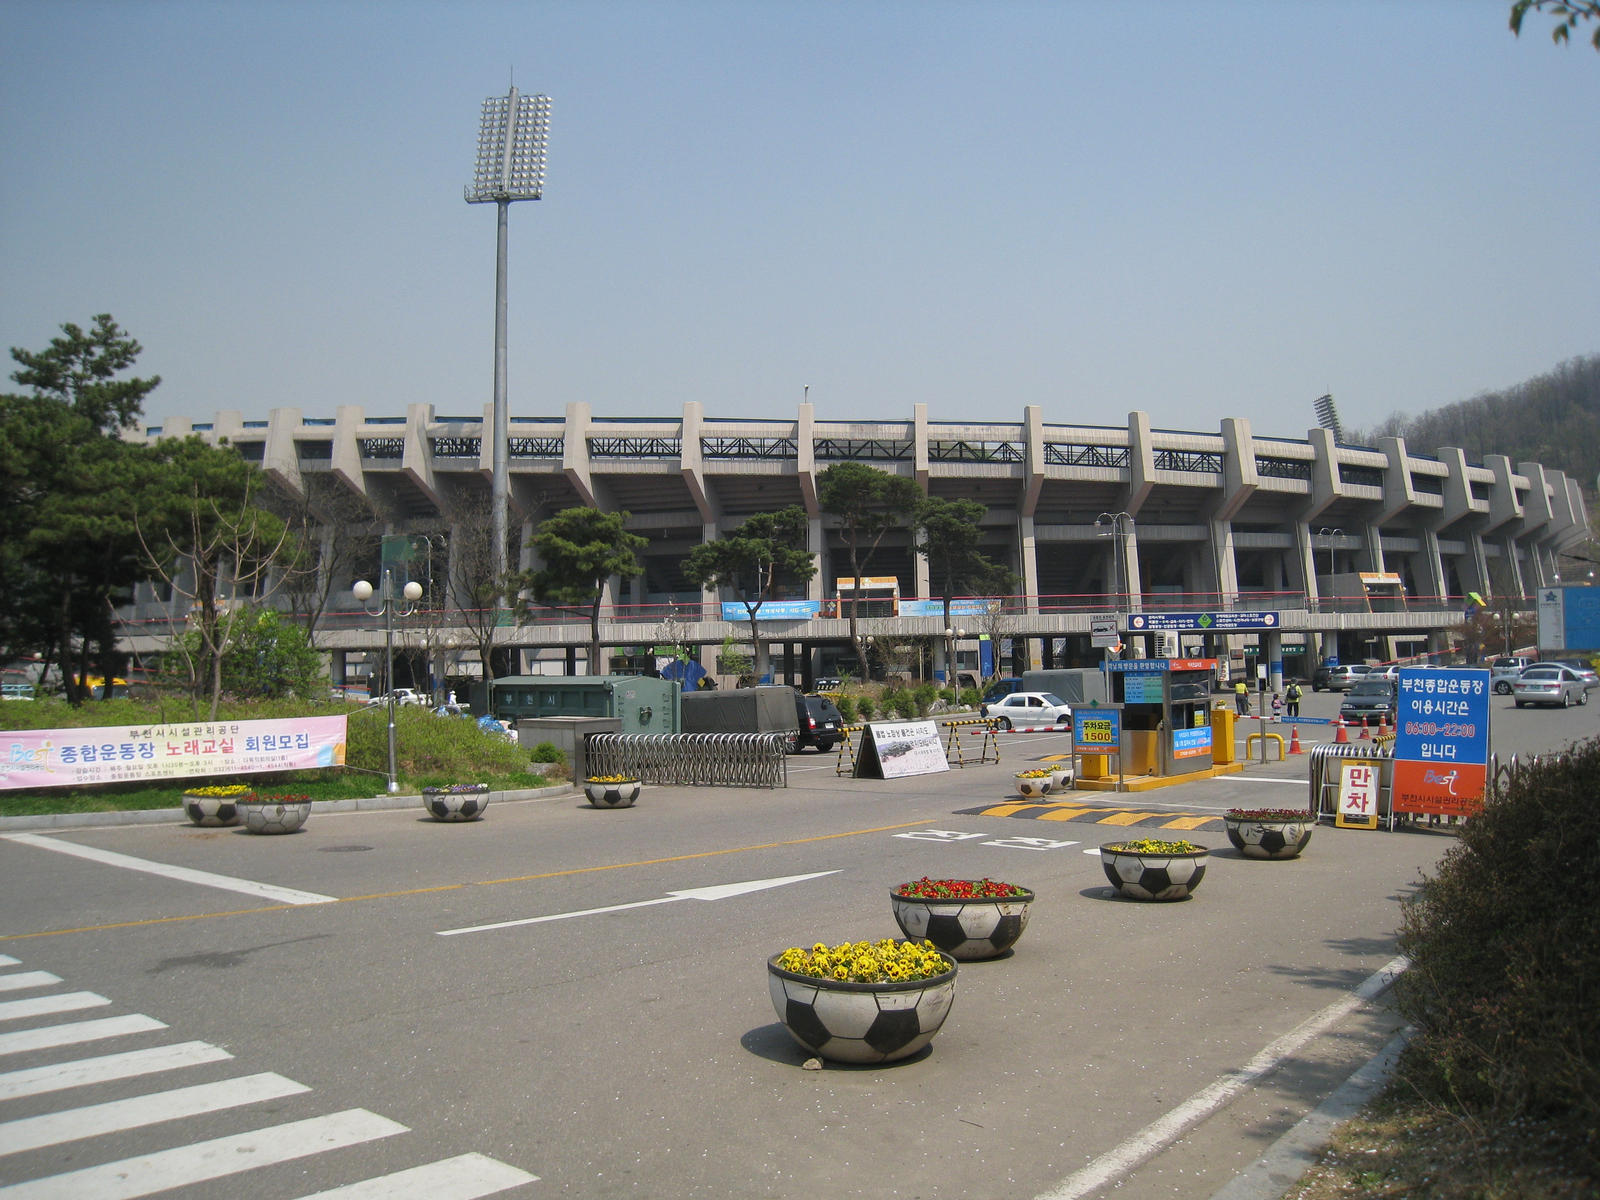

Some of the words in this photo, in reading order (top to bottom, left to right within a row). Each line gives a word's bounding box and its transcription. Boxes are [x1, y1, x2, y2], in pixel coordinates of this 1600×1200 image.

[1402, 679, 1484, 695] 부천종합운동장
[1411, 699, 1470, 716] 이용시간은
[129, 725, 239, 739] 부천시시설관리공단
[1083, 721, 1111, 731] 주차요금
[1405, 721, 1476, 738] 06:00~22:00
[1084, 732, 1111, 741] 1500
[60, 742, 155, 764] 종합운동장
[166, 737, 235, 756] 노래교실
[245, 733, 309, 752] 회원모집
[1421, 743, 1457, 758] 입니다
[1346, 768, 1371, 812] 만차
[1424, 770, 1461, 796] Best
